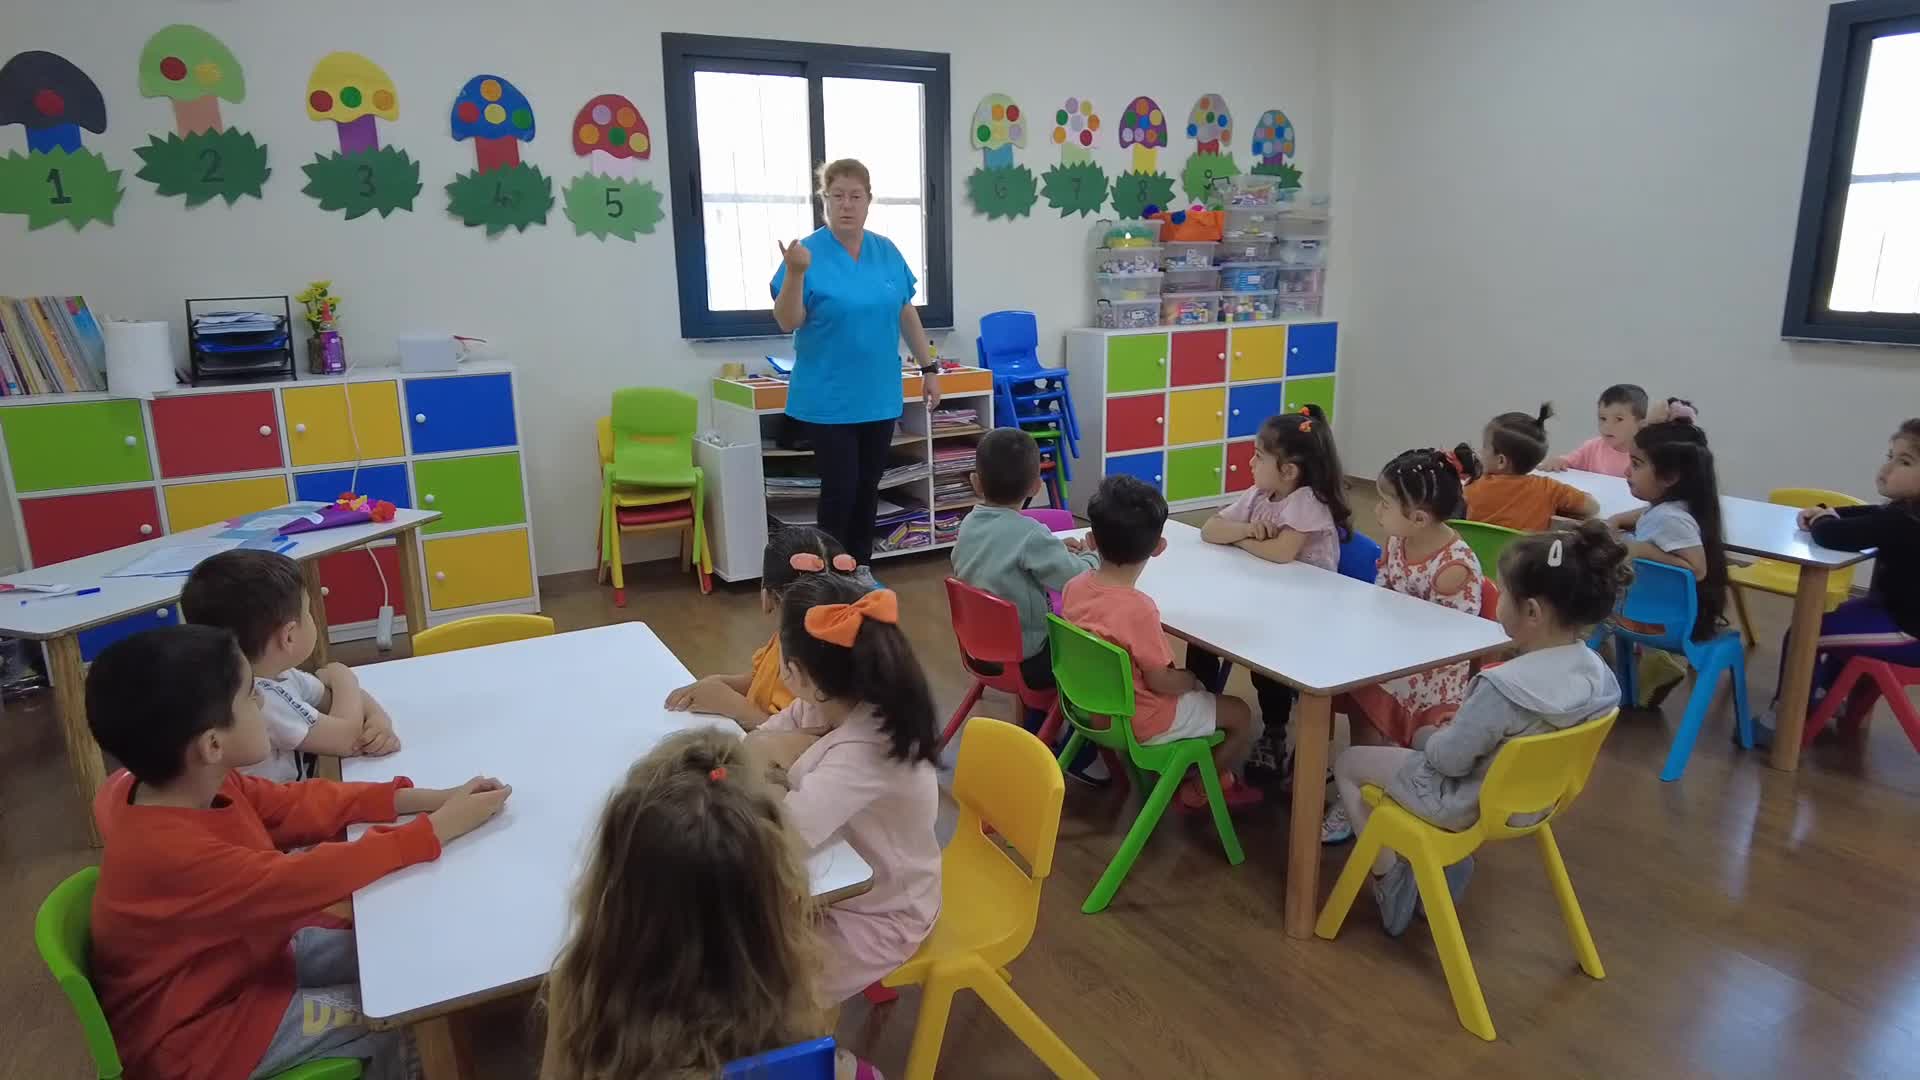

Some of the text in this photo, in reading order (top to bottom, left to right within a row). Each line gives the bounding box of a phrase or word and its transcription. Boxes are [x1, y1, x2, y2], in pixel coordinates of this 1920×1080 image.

[199, 148, 225, 183] 2
[357, 164, 376, 197] 3
[47, 168, 72, 204] 1
[493, 181, 521, 211] 4
[994, 176, 1008, 200] 6
[1071, 177, 1082, 200] 7
[1136, 179, 1149, 202] 8
[605, 187, 624, 218] 5
